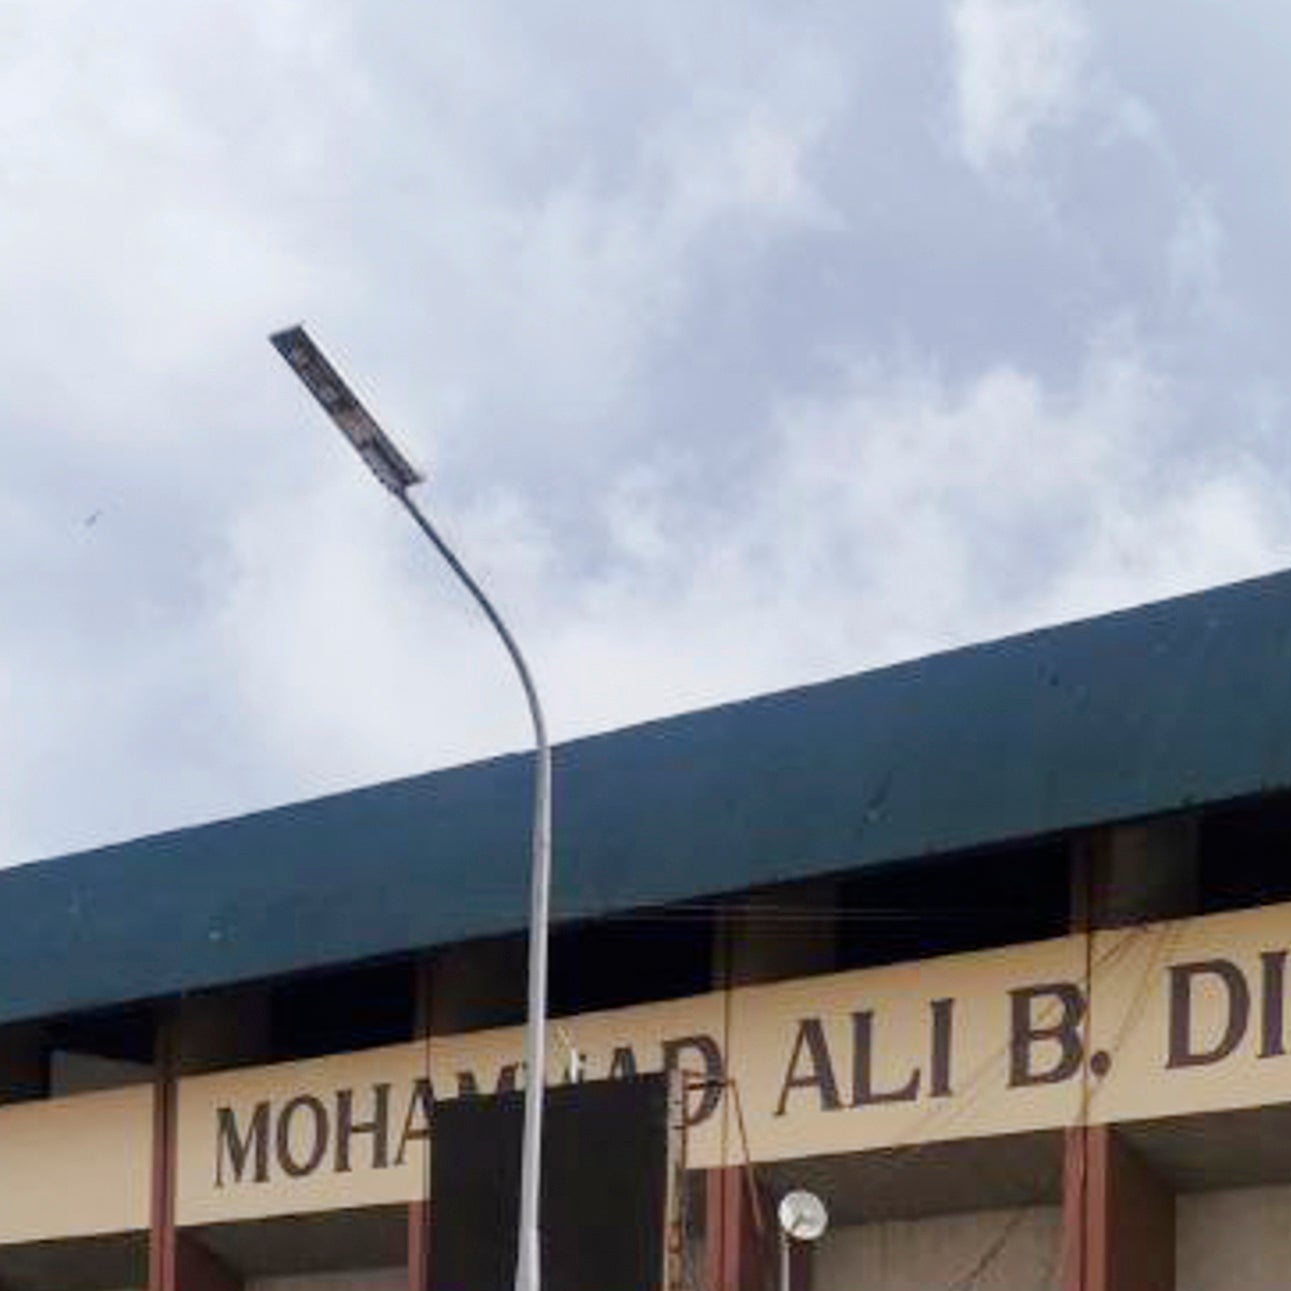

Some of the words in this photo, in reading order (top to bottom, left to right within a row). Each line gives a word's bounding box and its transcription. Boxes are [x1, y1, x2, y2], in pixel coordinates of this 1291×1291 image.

[214, 1035, 723, 1188] MOHAD
[774, 998, 954, 1117] ALI
[1006, 981, 1110, 1089] B.
